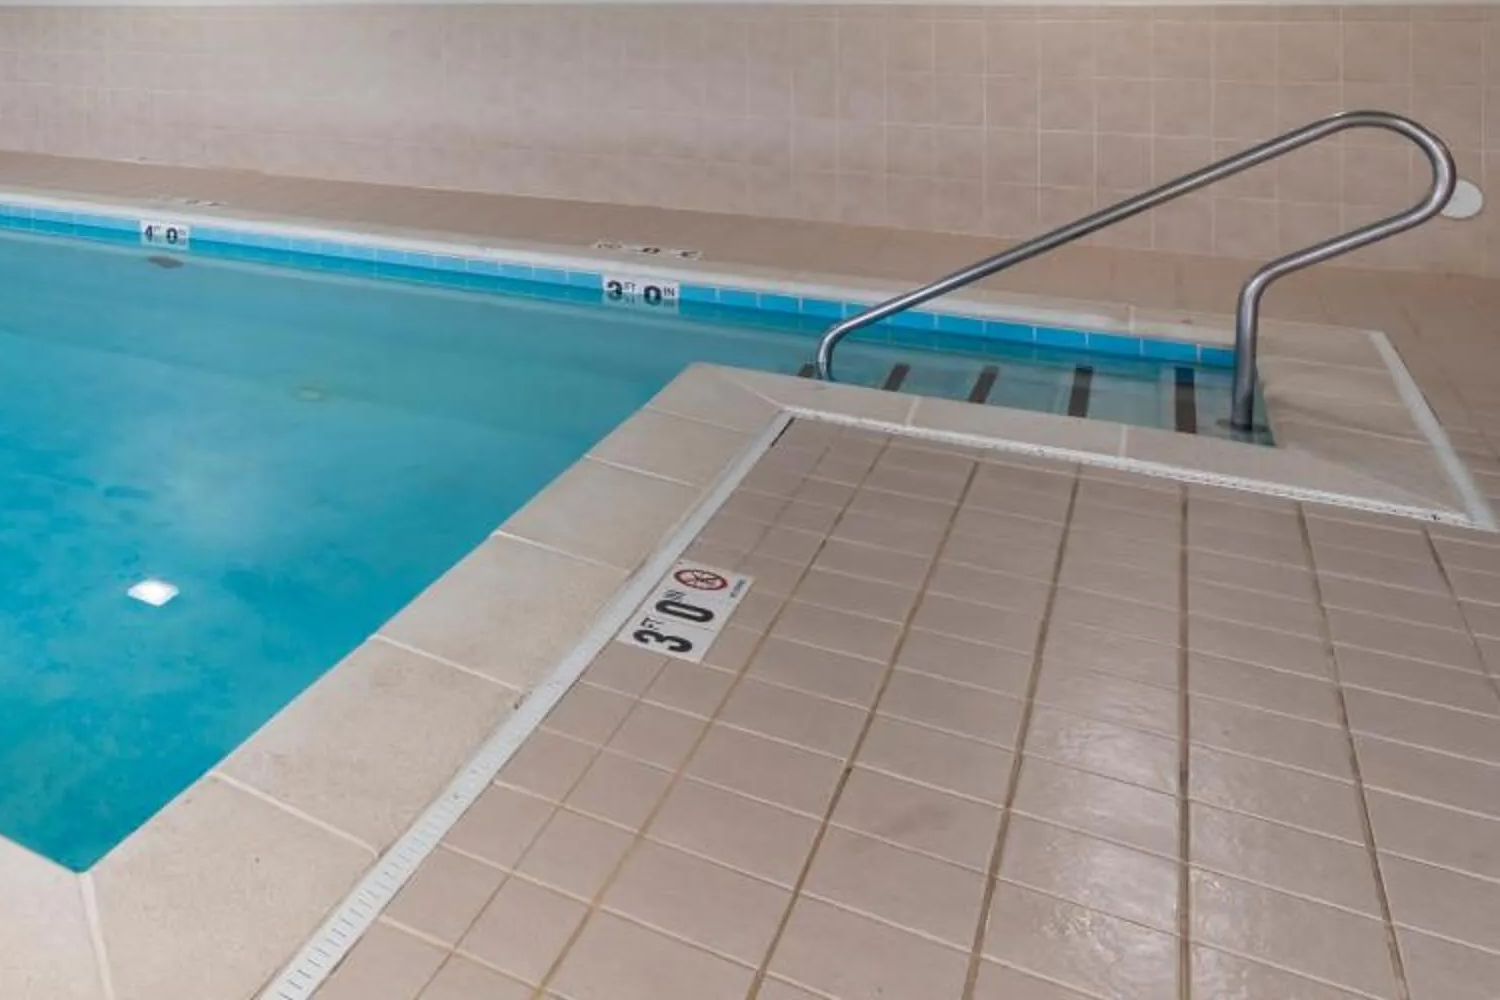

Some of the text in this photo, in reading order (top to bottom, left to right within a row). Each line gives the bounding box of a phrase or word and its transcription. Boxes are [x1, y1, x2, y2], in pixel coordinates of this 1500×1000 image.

[607, 280, 622, 301] 3
[644, 285, 661, 306] 0
[655, 600, 714, 622] 0
[640, 617, 663, 631] FT
[633, 629, 693, 652] 3
